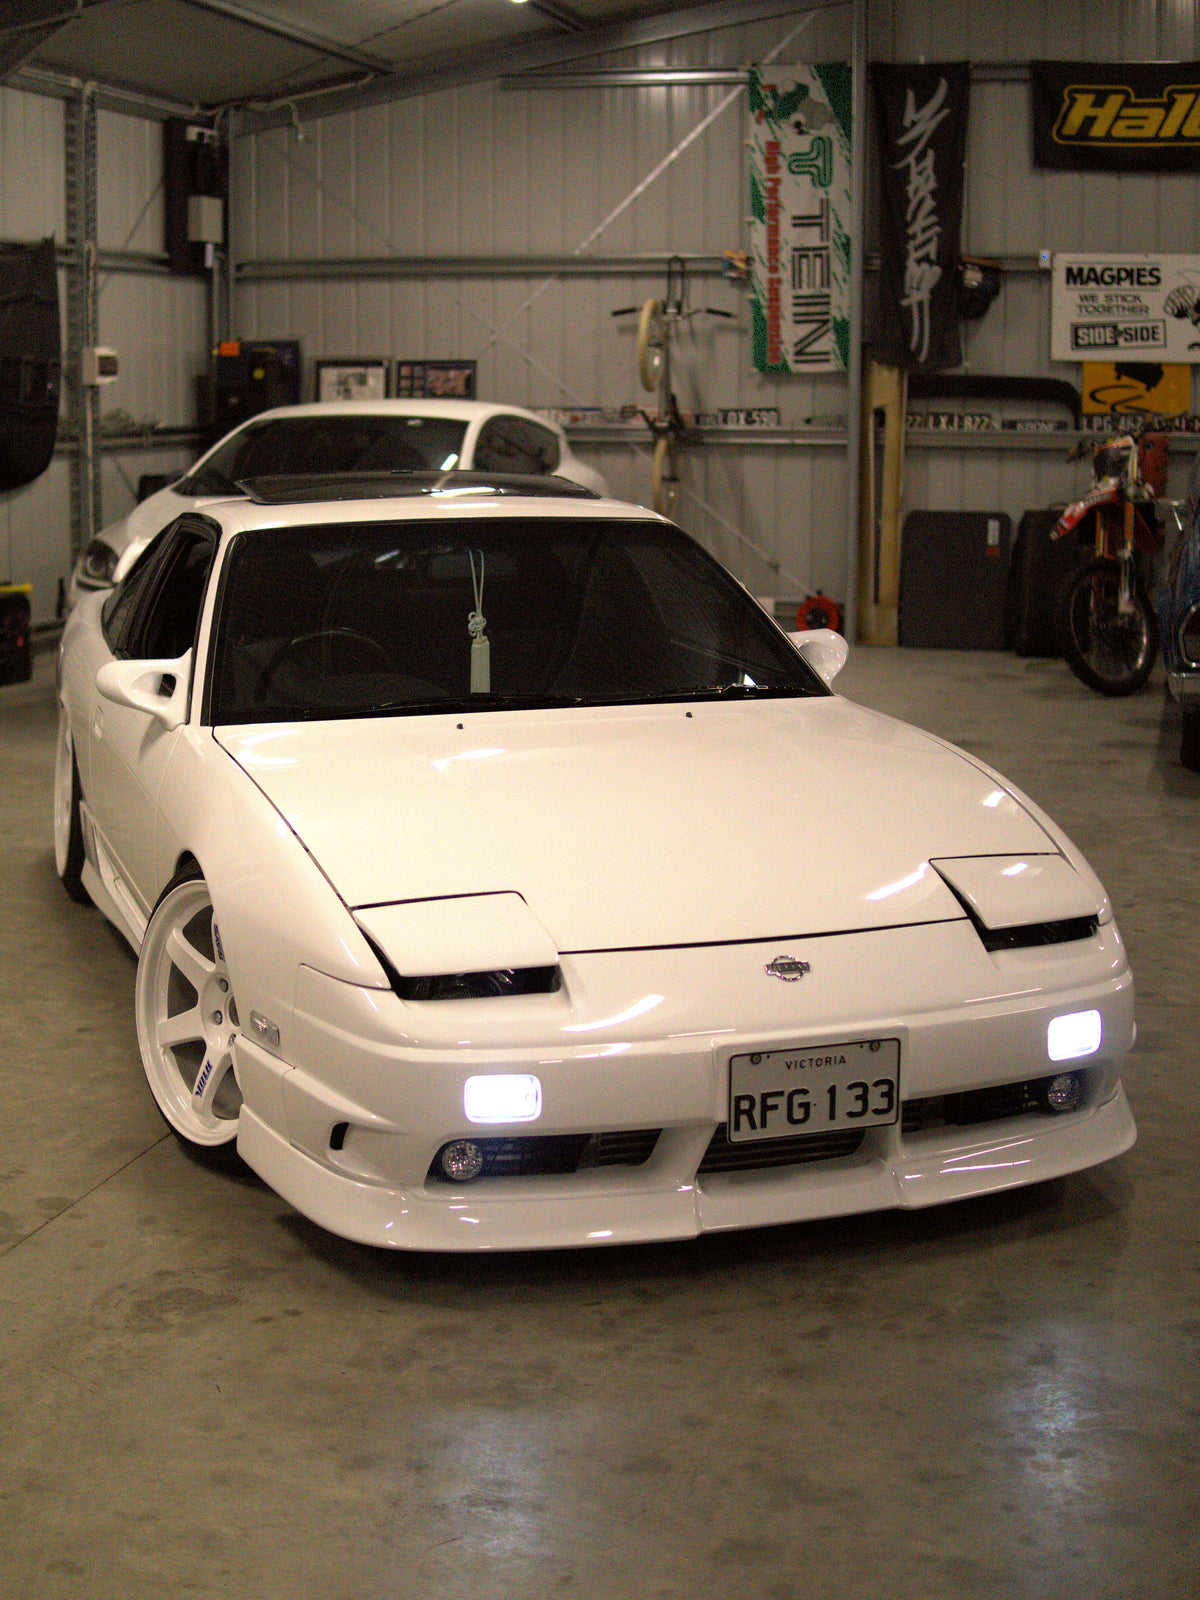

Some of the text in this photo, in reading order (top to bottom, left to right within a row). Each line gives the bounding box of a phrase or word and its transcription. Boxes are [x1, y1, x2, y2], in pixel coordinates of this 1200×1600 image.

[764, 140, 783, 364] High Performance Suspension
[791, 197, 831, 364] TEIN
[1065, 266, 1162, 286] MAGPIES
[1079, 293, 1142, 303] WE STICK
[1077, 303, 1149, 314] TOGETHER
[1078, 326, 1117, 346] SIDE
[1123, 326, 1160, 342] SIDE
[785, 1055, 847, 1070] VICTORIA
[733, 1078, 895, 1132] RFG 133
